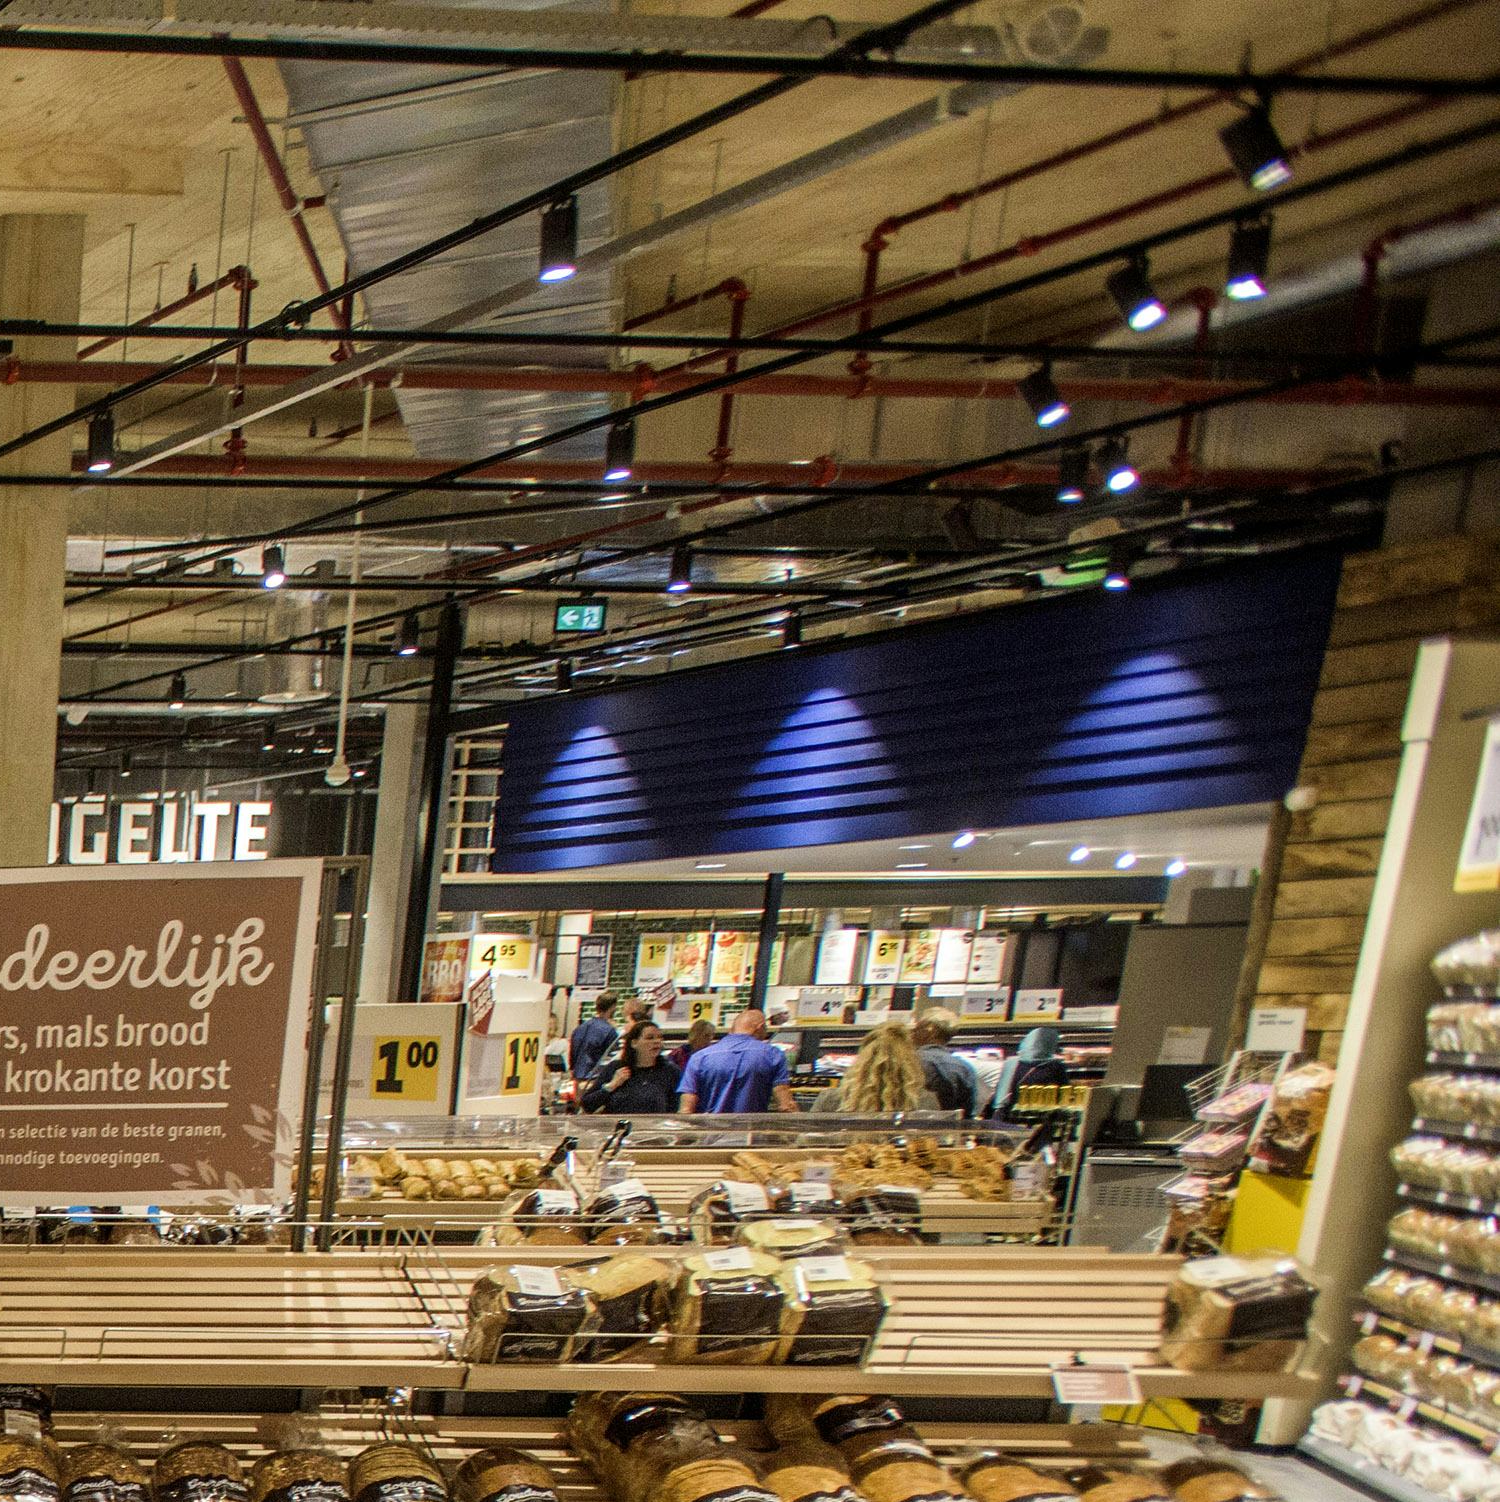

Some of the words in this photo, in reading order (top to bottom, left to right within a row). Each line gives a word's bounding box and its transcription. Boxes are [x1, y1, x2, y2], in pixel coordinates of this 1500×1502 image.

[35, 1014, 109, 1050] mals
[115, 1012, 211, 1048] brood
[4, 1059, 140, 1095] krokante
[147, 1058, 232, 1093] korst
[8, 1123, 68, 1141] selectie
[70, 1125, 98, 1140] van
[100, 1123, 120, 1139] de
[122, 1121, 165, 1139] beste
[168, 1124, 227, 1142] granen,
[57, 1148, 165, 1169] toevoegingen.
